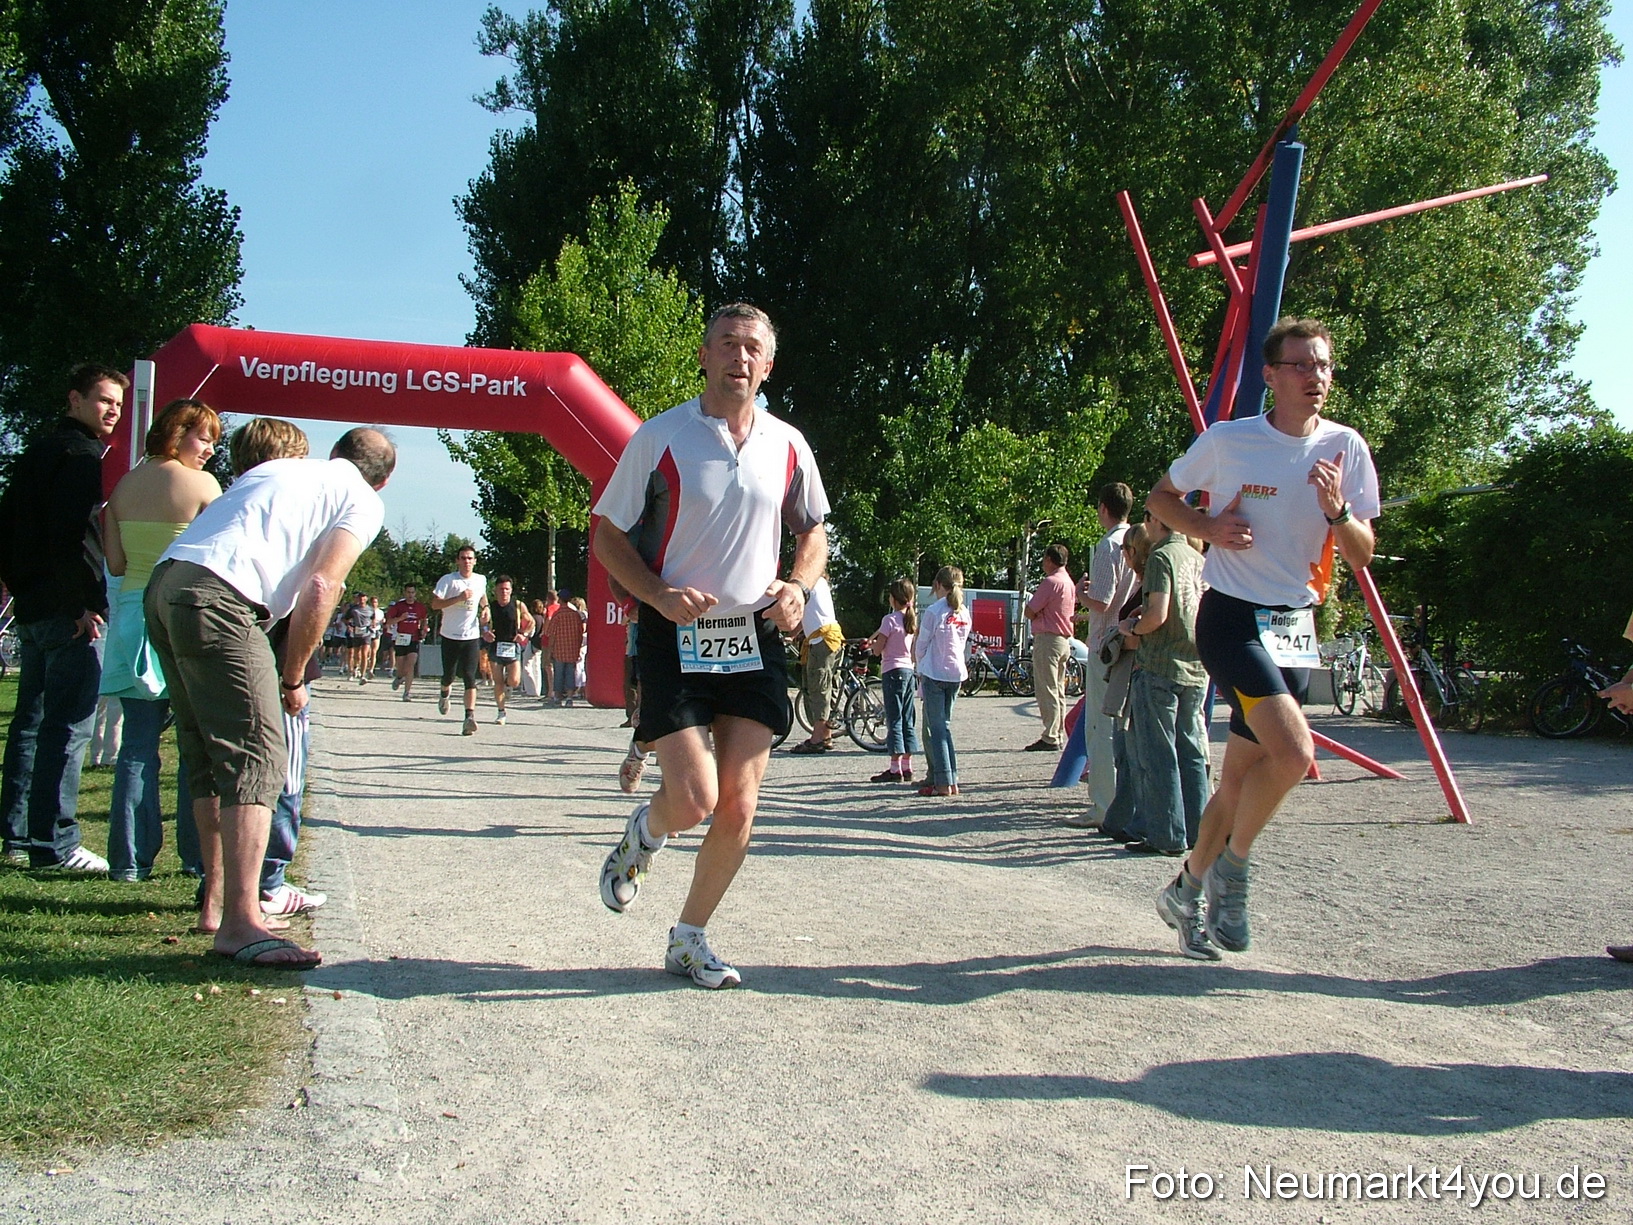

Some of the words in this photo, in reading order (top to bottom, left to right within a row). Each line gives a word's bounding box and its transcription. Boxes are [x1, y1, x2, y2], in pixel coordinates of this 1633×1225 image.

[239, 355, 397, 394] Verpflegung
[406, 368, 527, 397] LGS-Park
[1242, 484, 1278, 496] MERZ
[697, 616, 747, 629] Hermann
[1271, 615, 1298, 628] Holger
[682, 635, 692, 646] A
[700, 636, 753, 658] 2754
[1274, 634, 1311, 651] 2247
